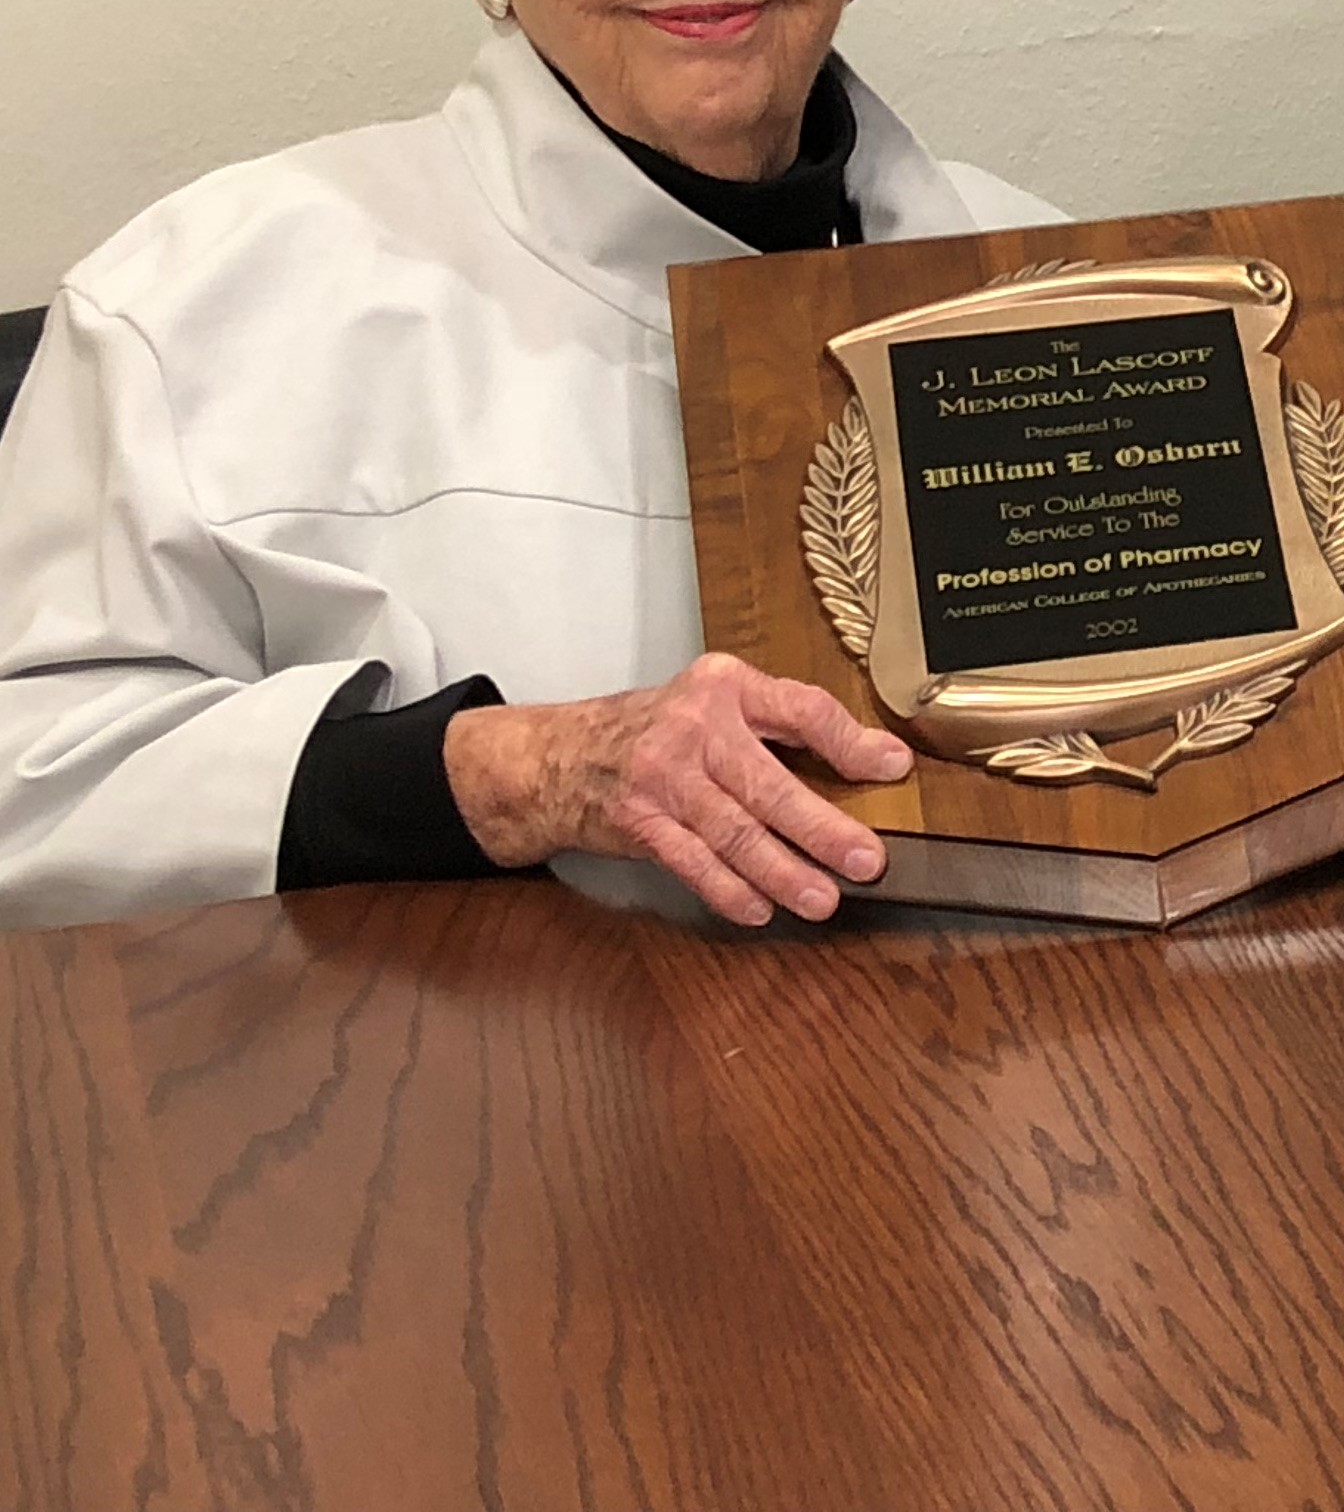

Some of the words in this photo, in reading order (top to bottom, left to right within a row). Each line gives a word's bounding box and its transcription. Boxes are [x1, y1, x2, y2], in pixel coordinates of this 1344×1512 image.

[1050, 340, 1081, 355] The
[921, 370, 956, 392] J.
[971, 362, 1057, 387] LEON
[1072, 347, 1214, 377] LASCOFF
[938, 388, 1095, 418] MEMORIAL
[1102, 375, 1207, 401] AWARD
[1024, 417, 1109, 440] Presented
[1112, 416, 1134, 431] To
[922, 460, 1056, 489] William
[1065, 450, 1103, 474] E.
[1115, 439, 1242, 469] Osborn
[999, 501, 1036, 521] For
[1044, 486, 1182, 515] Outstanding
[1006, 522, 1095, 546] Service
[1102, 516, 1131, 534] To
[1139, 509, 1180, 530] The
[937, 561, 1076, 592] Profession
[1084, 552, 1112, 573] of
[1121, 537, 1263, 569] Pharmacy
[942, 599, 1029, 620] AMERICAN
[1034, 589, 1110, 608] COLLEGE
[1143, 570, 1267, 595] APOTHECARIES
[1086, 618, 1138, 640] 2002
